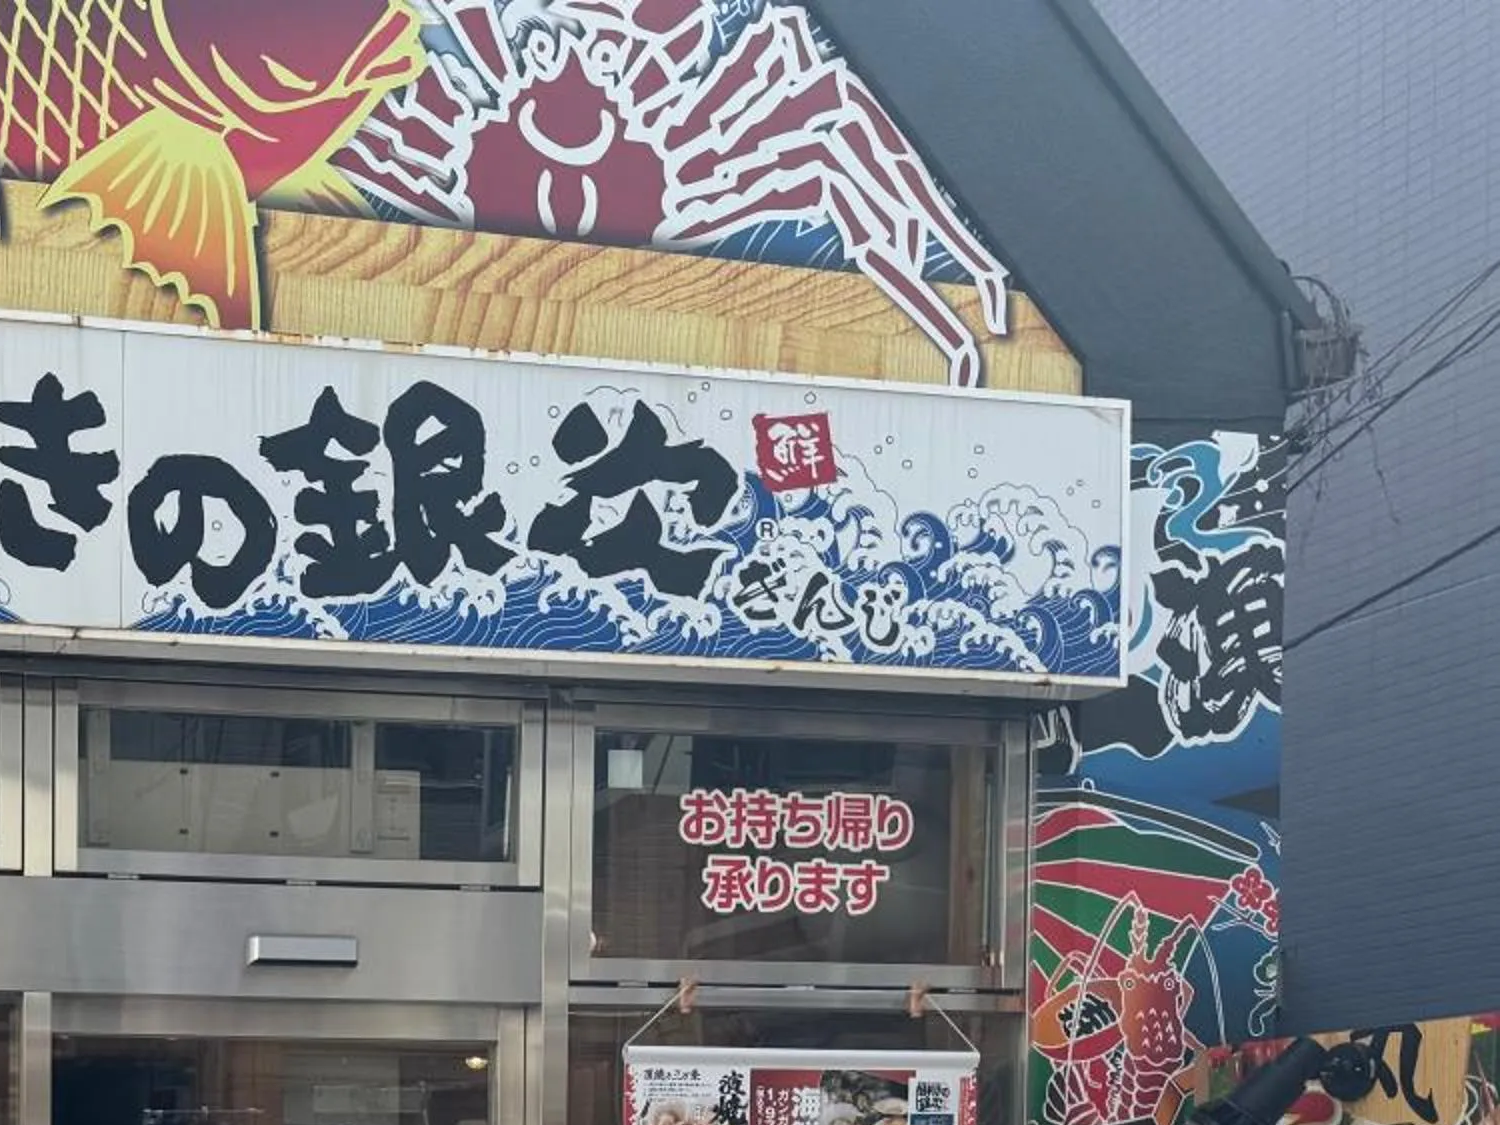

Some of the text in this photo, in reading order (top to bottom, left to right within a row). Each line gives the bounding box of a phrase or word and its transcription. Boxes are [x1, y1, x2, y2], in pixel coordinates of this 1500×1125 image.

[766, 415, 830, 486] 鮮
[736, 553, 908, 650] ぎんじ
[679, 788, 914, 851] お持ち帰り
[701, 854, 890, 915] 承ります
